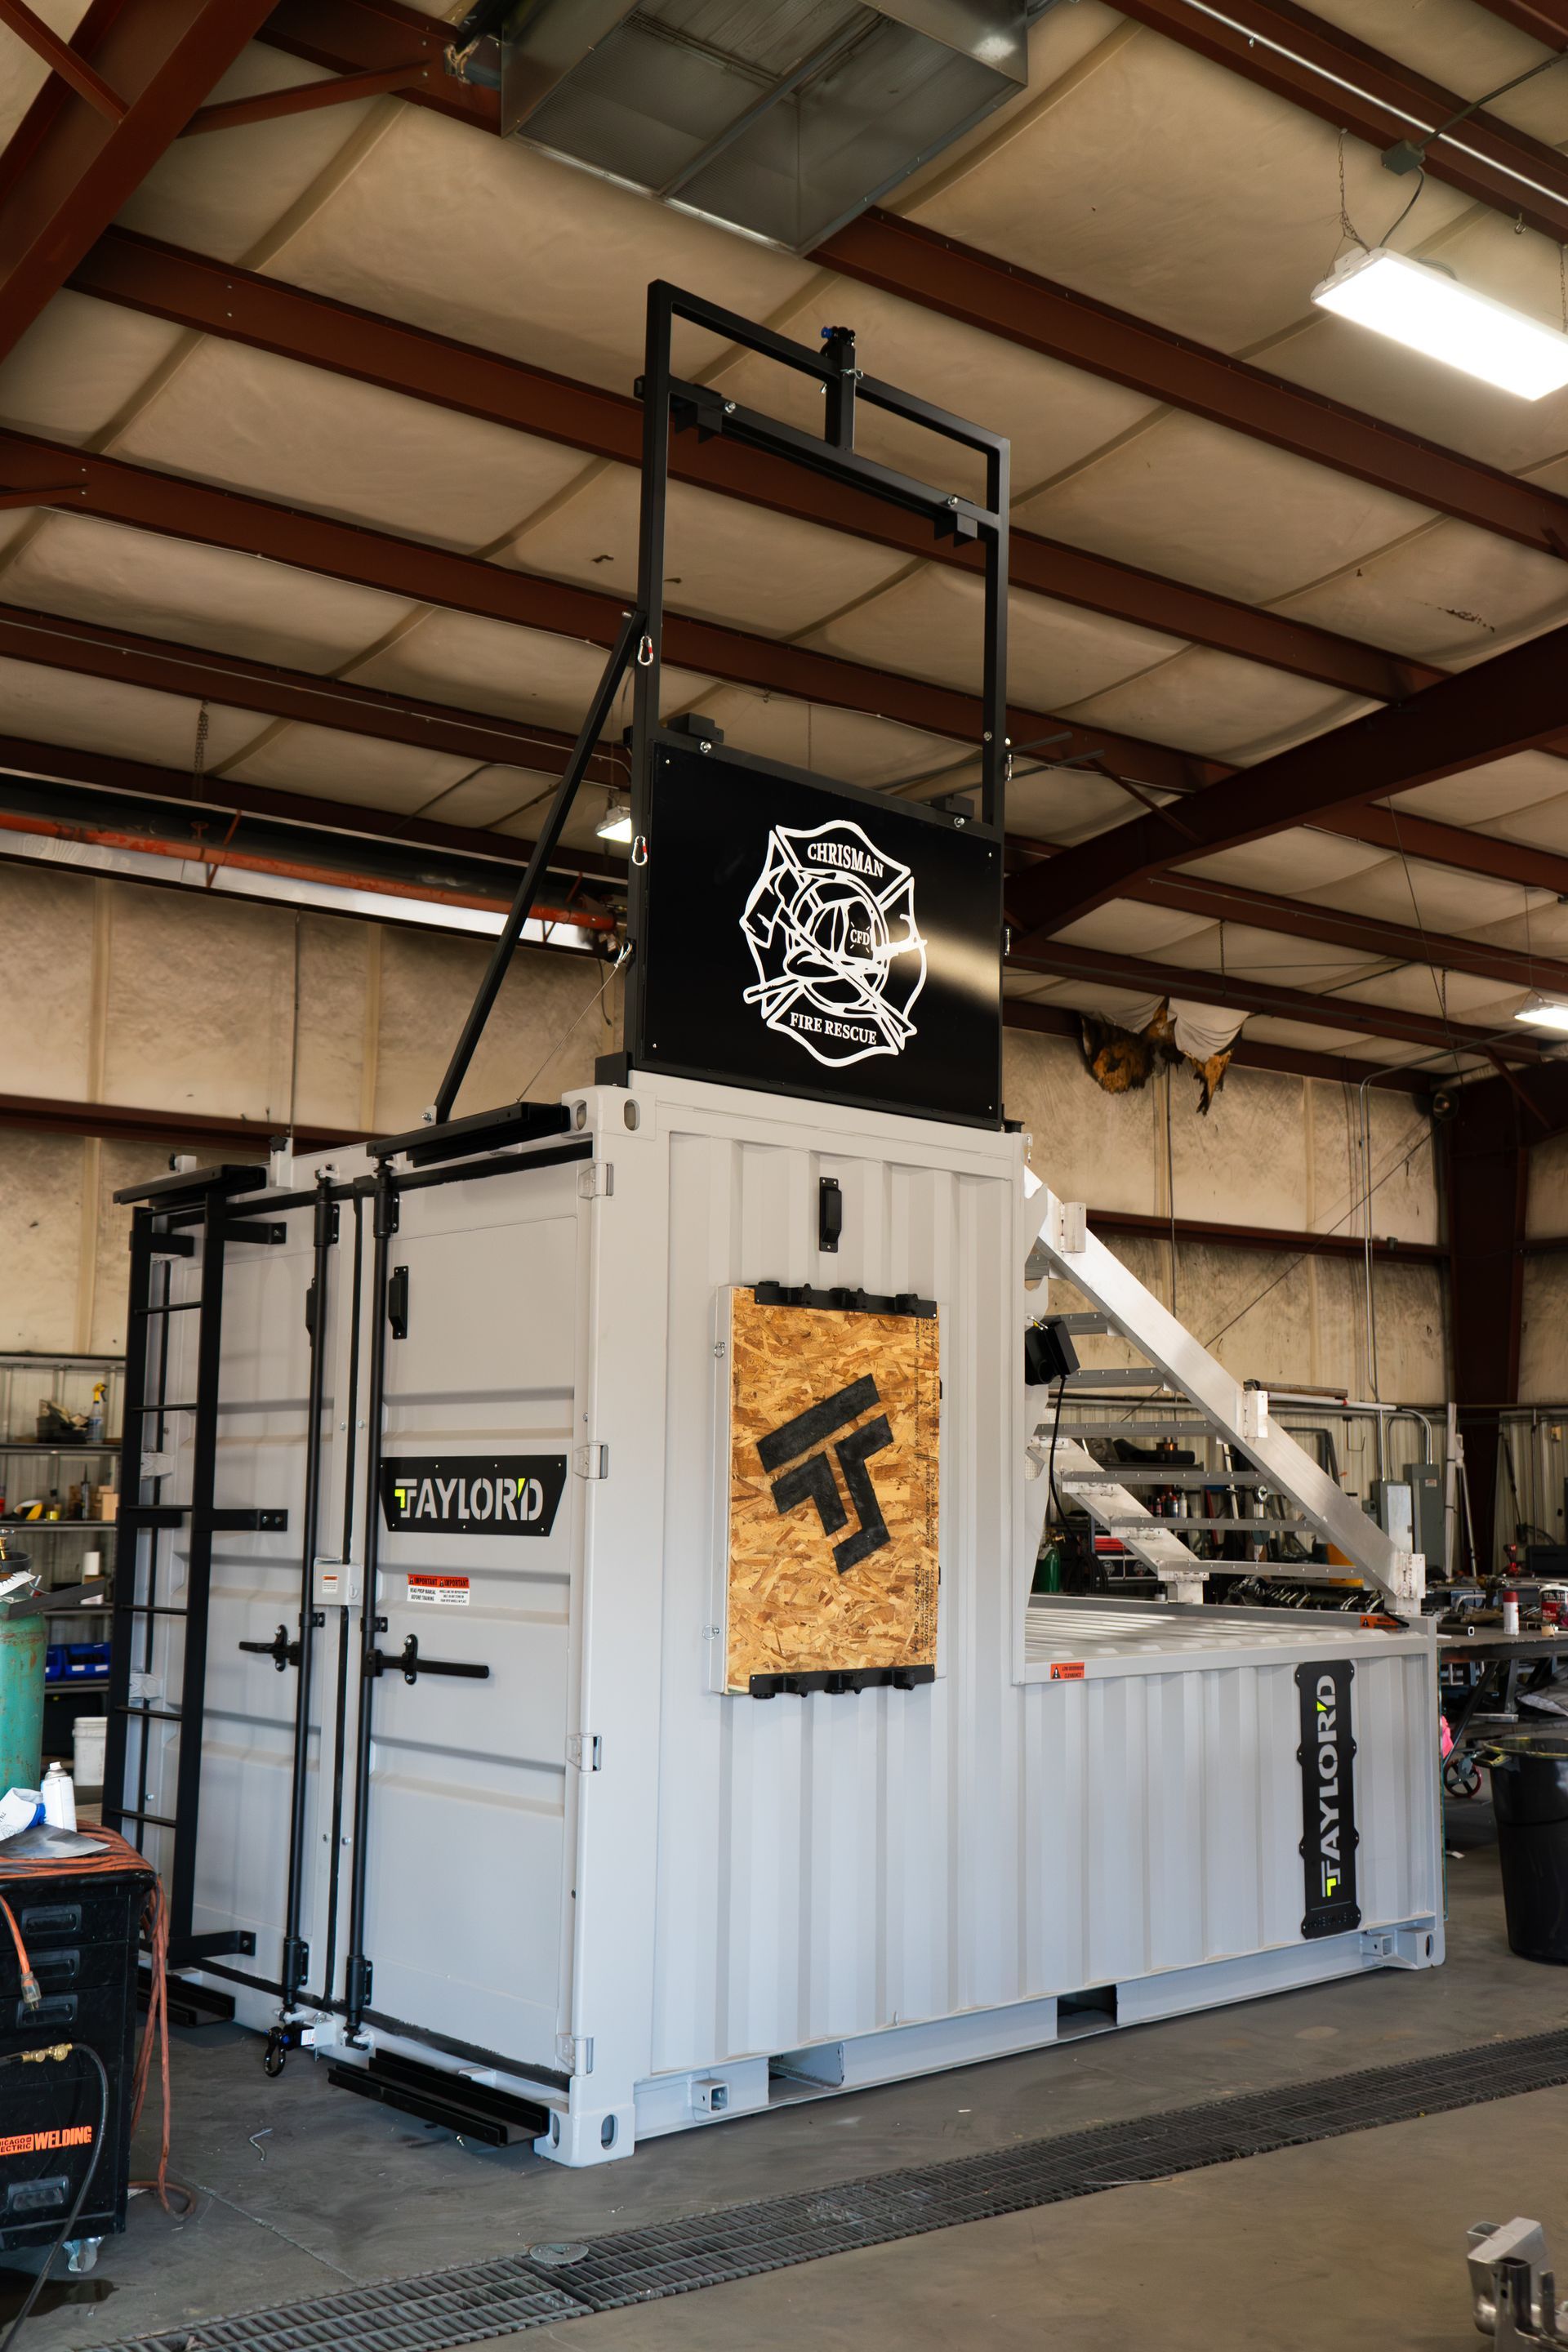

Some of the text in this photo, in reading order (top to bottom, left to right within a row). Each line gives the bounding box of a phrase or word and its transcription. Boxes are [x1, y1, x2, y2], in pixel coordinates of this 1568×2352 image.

[807, 842, 884, 878] CHRISMAN
[849, 929, 871, 946] CFD
[790, 1012, 877, 1045] FIRE RESCUE
[394, 1477, 544, 1521] TAYLOR'D
[1316, 1675, 1342, 1898] TAYLOR'D
[0, 2143, 32, 2153] ECTRIC
[34, 2126, 92, 2151] WELDING
